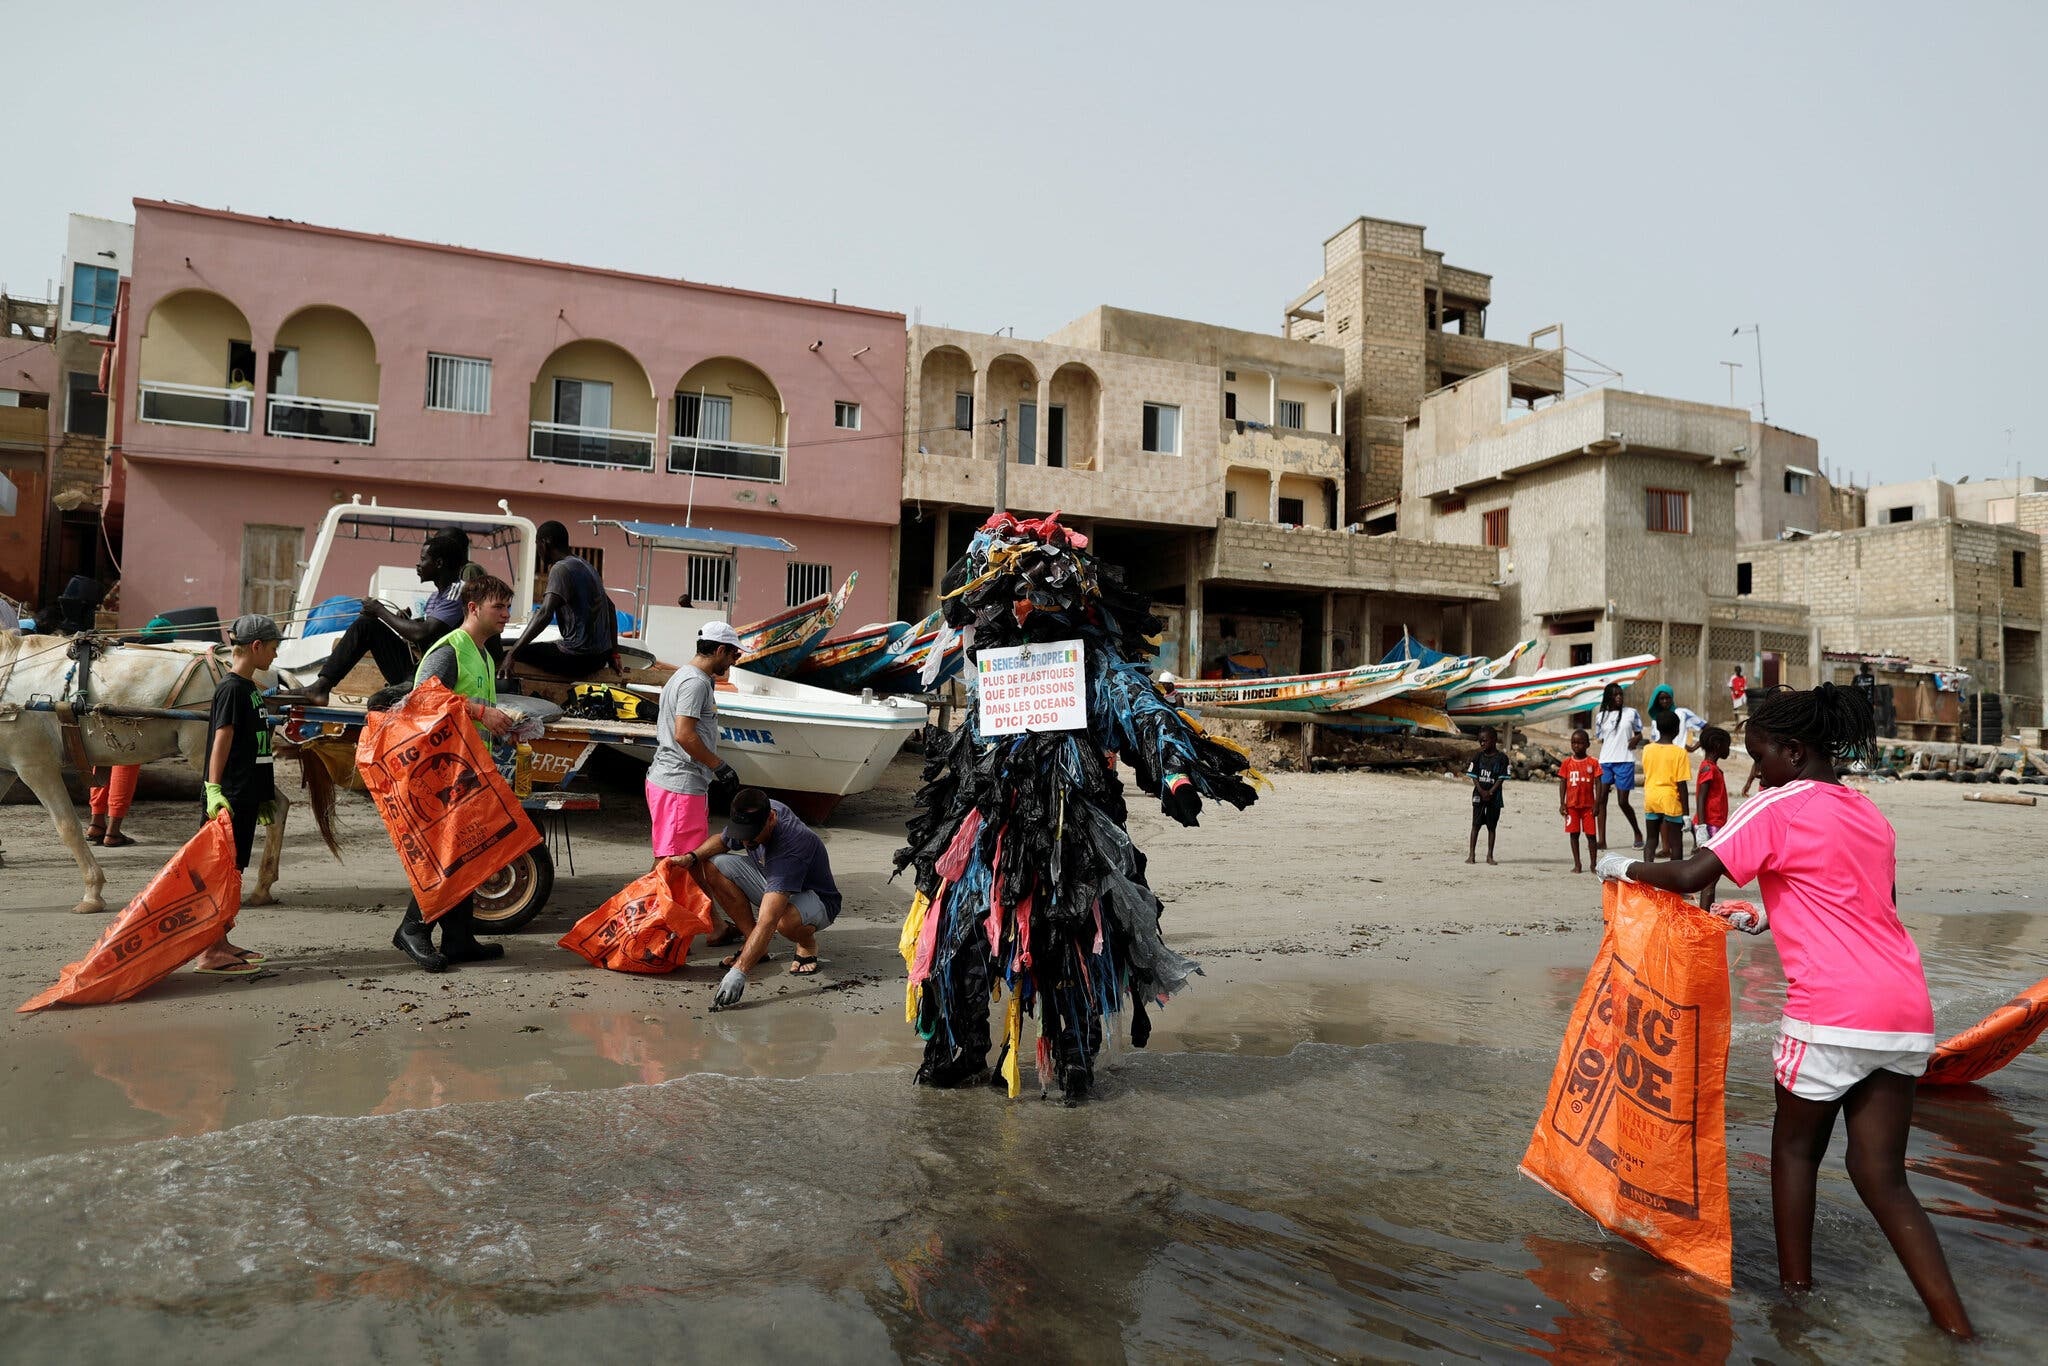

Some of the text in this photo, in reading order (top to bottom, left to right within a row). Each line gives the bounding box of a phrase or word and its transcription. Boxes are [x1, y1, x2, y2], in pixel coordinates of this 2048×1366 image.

[992, 651, 1064, 672] SENEGAL PROPRE
[983, 667, 1075, 687] PLUS DE PLASTIQUES
[985, 681, 1075, 701] QUE DE POISSONS
[985, 696, 1076, 715] DANS LES OCEANS
[995, 712, 1058, 728] D'ICI 2050
[1630, 1187, 1668, 1209] INDIA
